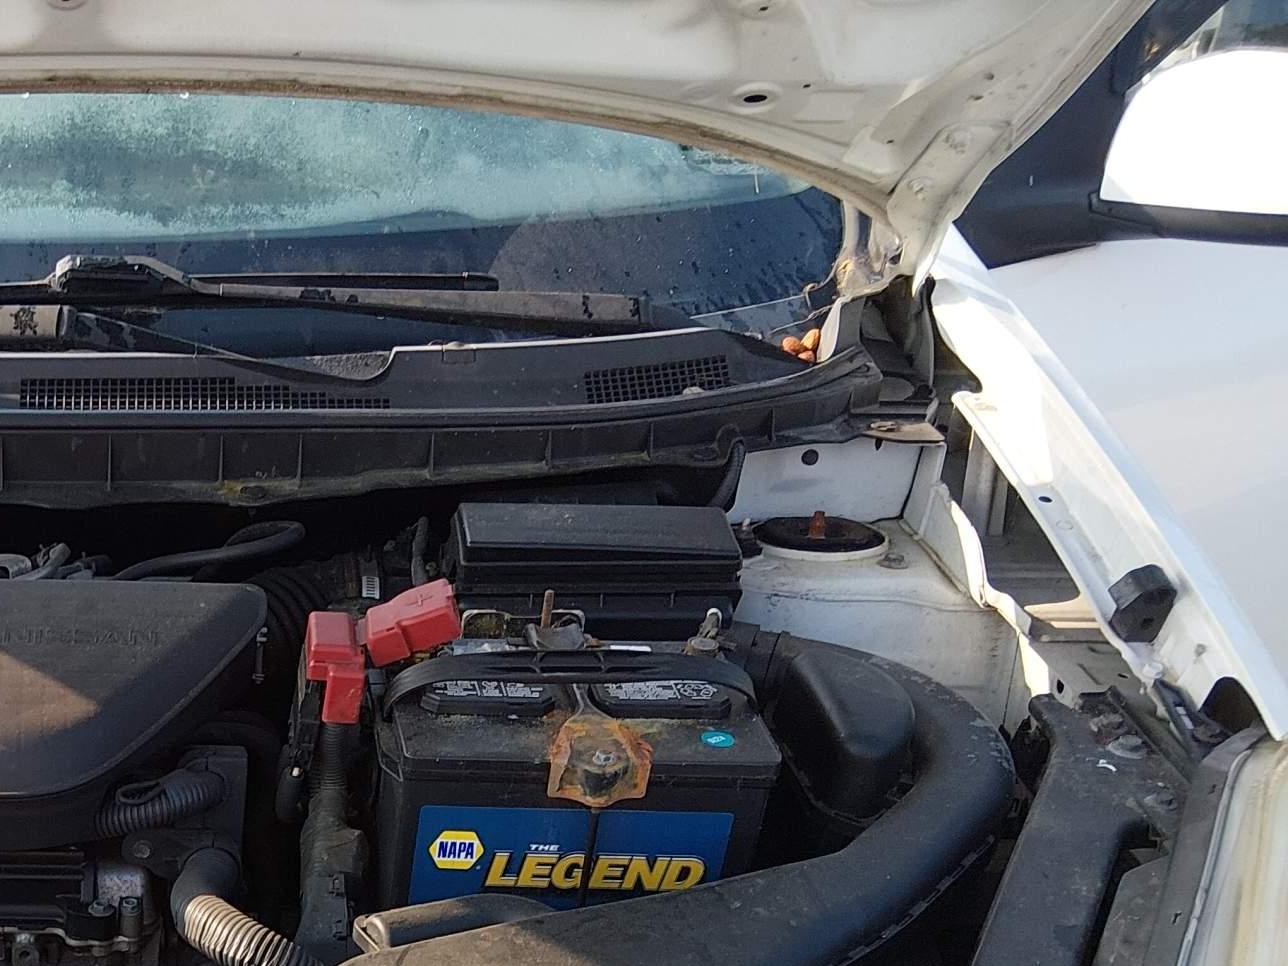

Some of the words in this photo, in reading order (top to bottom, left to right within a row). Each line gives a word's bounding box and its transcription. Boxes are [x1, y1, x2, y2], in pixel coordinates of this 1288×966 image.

[1, 628, 161, 647] NISSAN
[437, 841, 475, 859] NAPA
[485, 851, 706, 891] LEGEND
